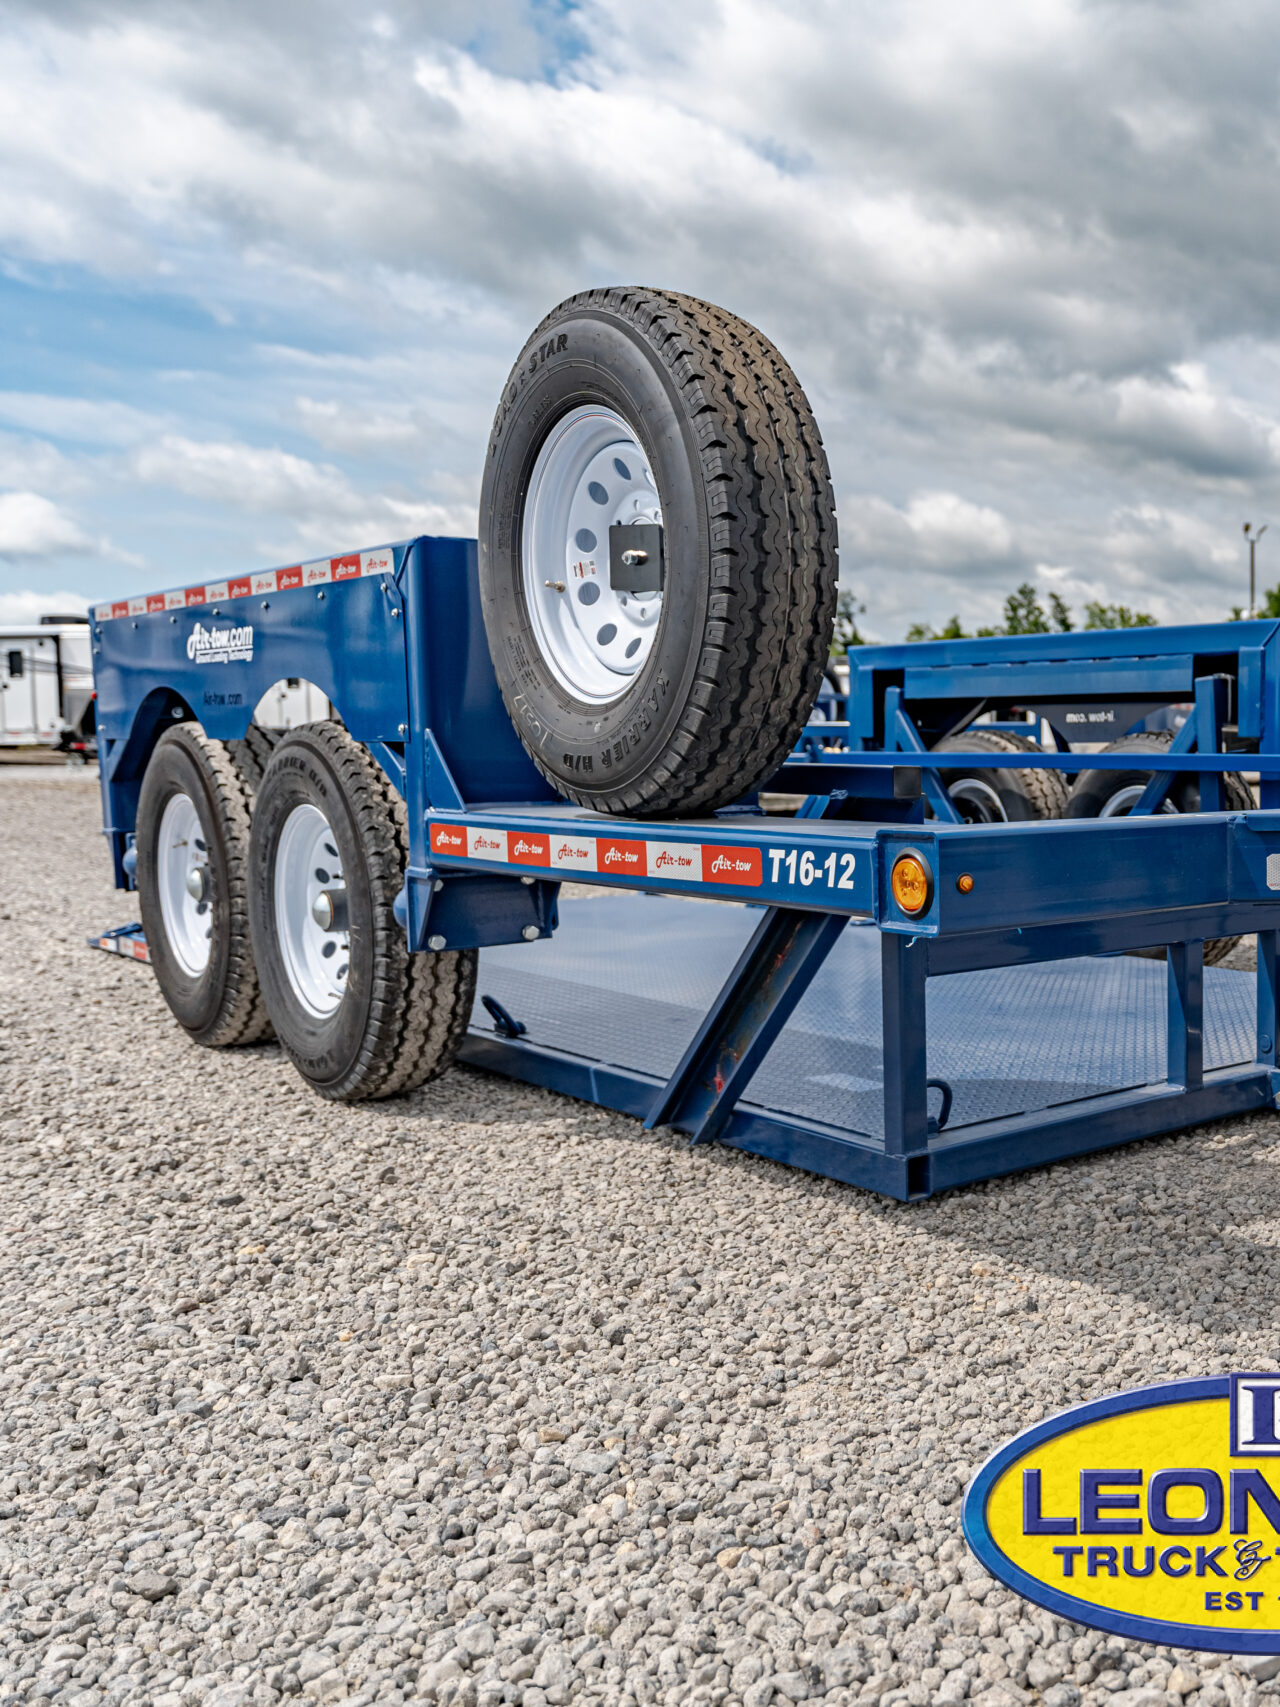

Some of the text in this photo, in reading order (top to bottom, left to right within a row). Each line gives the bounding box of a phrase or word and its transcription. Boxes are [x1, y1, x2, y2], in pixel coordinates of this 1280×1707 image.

[528, 333, 569, 374] STAR
[186, 622, 254, 660] Air-tow.com
[601, 668, 670, 769] KARRIER
[563, 753, 594, 773] H/D
[436, 831, 752, 874] Air-tow Air-tow Air-tow Air-tow Air-tow Air-tow Air-tow
[768, 848, 856, 890] T16-12
